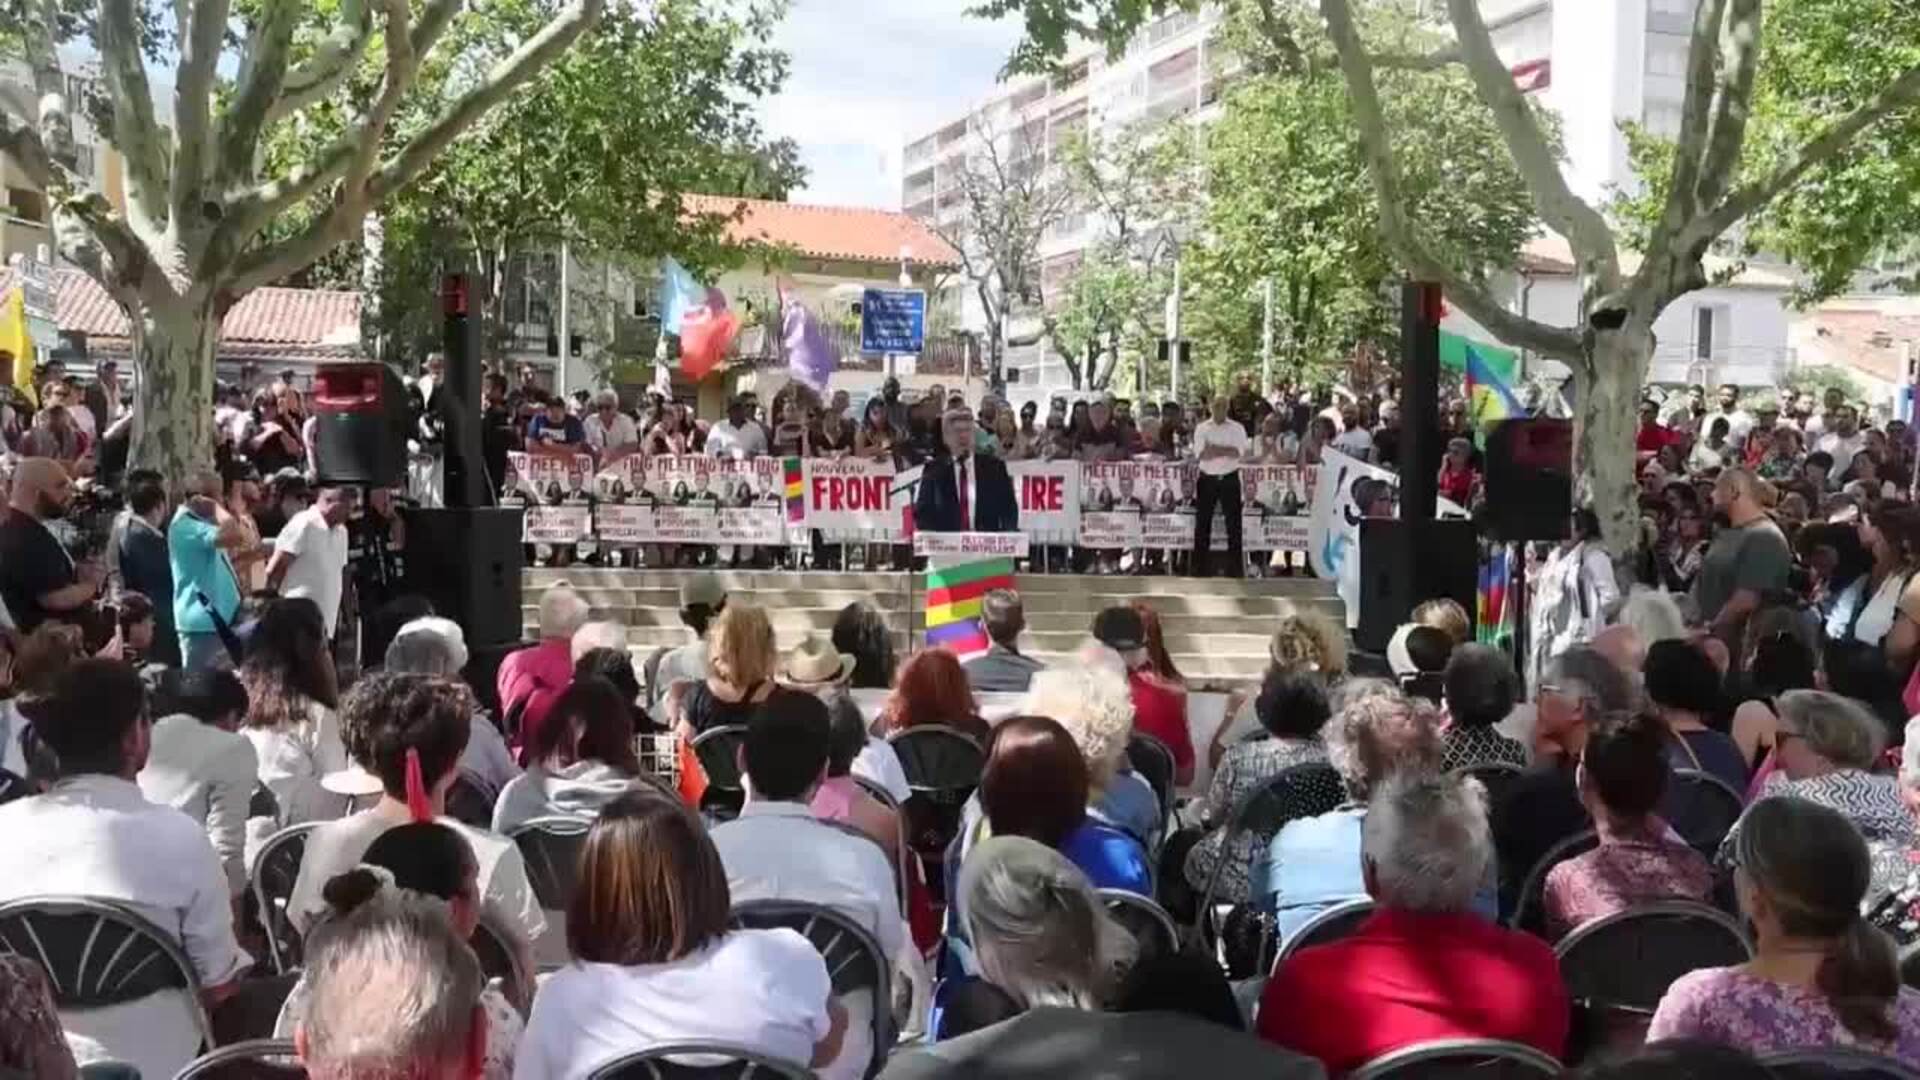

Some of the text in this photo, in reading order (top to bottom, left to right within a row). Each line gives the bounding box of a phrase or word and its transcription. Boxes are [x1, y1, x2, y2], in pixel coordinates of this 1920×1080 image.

[657, 456, 716, 473] MEETING
[720, 457, 780, 474] MEETING
[812, 463, 865, 474] NOUVEAU
[1083, 463, 1141, 479] MEETING
[812, 475, 895, 511] FRONT
